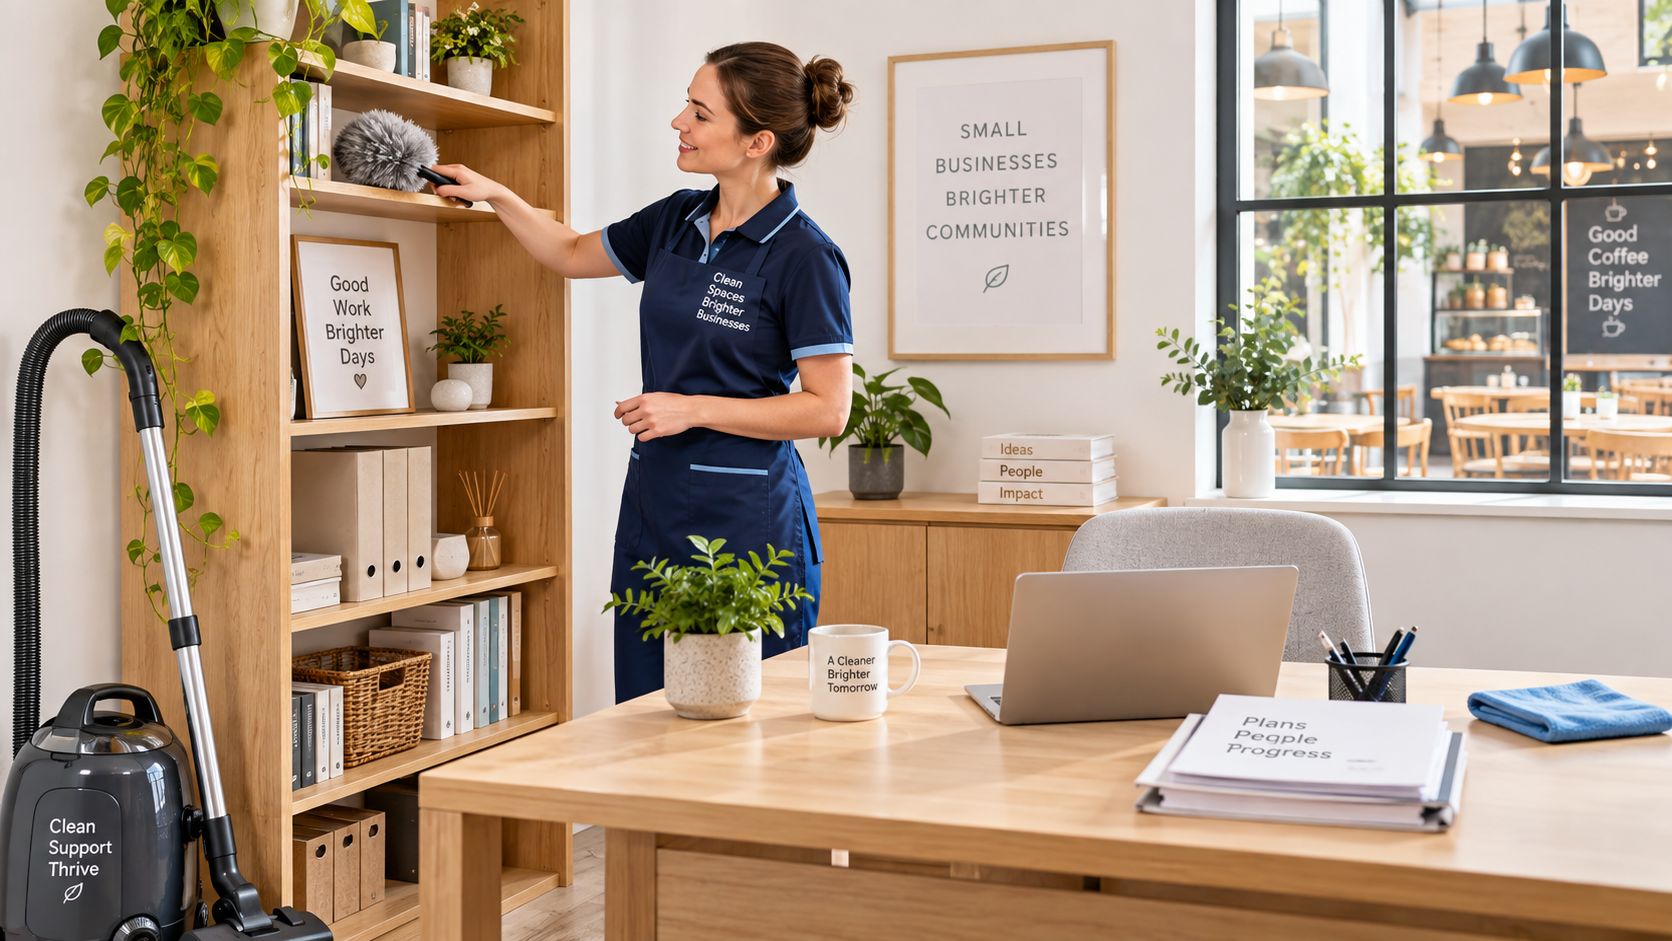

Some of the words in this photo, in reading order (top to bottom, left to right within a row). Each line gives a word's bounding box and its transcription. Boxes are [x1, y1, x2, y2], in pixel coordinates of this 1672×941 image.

[960, 120, 1028, 139] SMALL
[935, 153, 1058, 174] BUSINESSES
[946, 187, 1046, 206] BRIGHTER
[926, 221, 1069, 240] COMMUNITIES
[1588, 224, 1638, 243] Good
[1588, 247, 1649, 265] Coffee
[330, 275, 369, 292] Good
[713, 272, 743, 289] Clean
[1588, 270, 1662, 292] Brighter
[707, 284, 745, 303] Spaces
[333, 299, 372, 316] Work
[702, 296, 745, 317] Brighter
[1588, 294, 1634, 316] Days
[696, 308, 750, 332] Businesses
[325, 323, 385, 344] Brighter
[340, 348, 375, 368] Days
[1000, 443, 1033, 455] Ideas
[1000, 464, 1043, 480] People
[1000, 486, 1044, 502] Impact
[827, 655, 835, 666] A
[837, 655, 875, 666] Cleaner
[827, 668, 871, 682] Brighter
[827, 682, 878, 693] Tomorrow
[1242, 716, 1307, 730] Plans
[1226, 743, 1332, 759] Progress
[49, 818, 96, 834] Clean
[48, 840, 113, 858] Support
[48, 861, 100, 877] Thrive
